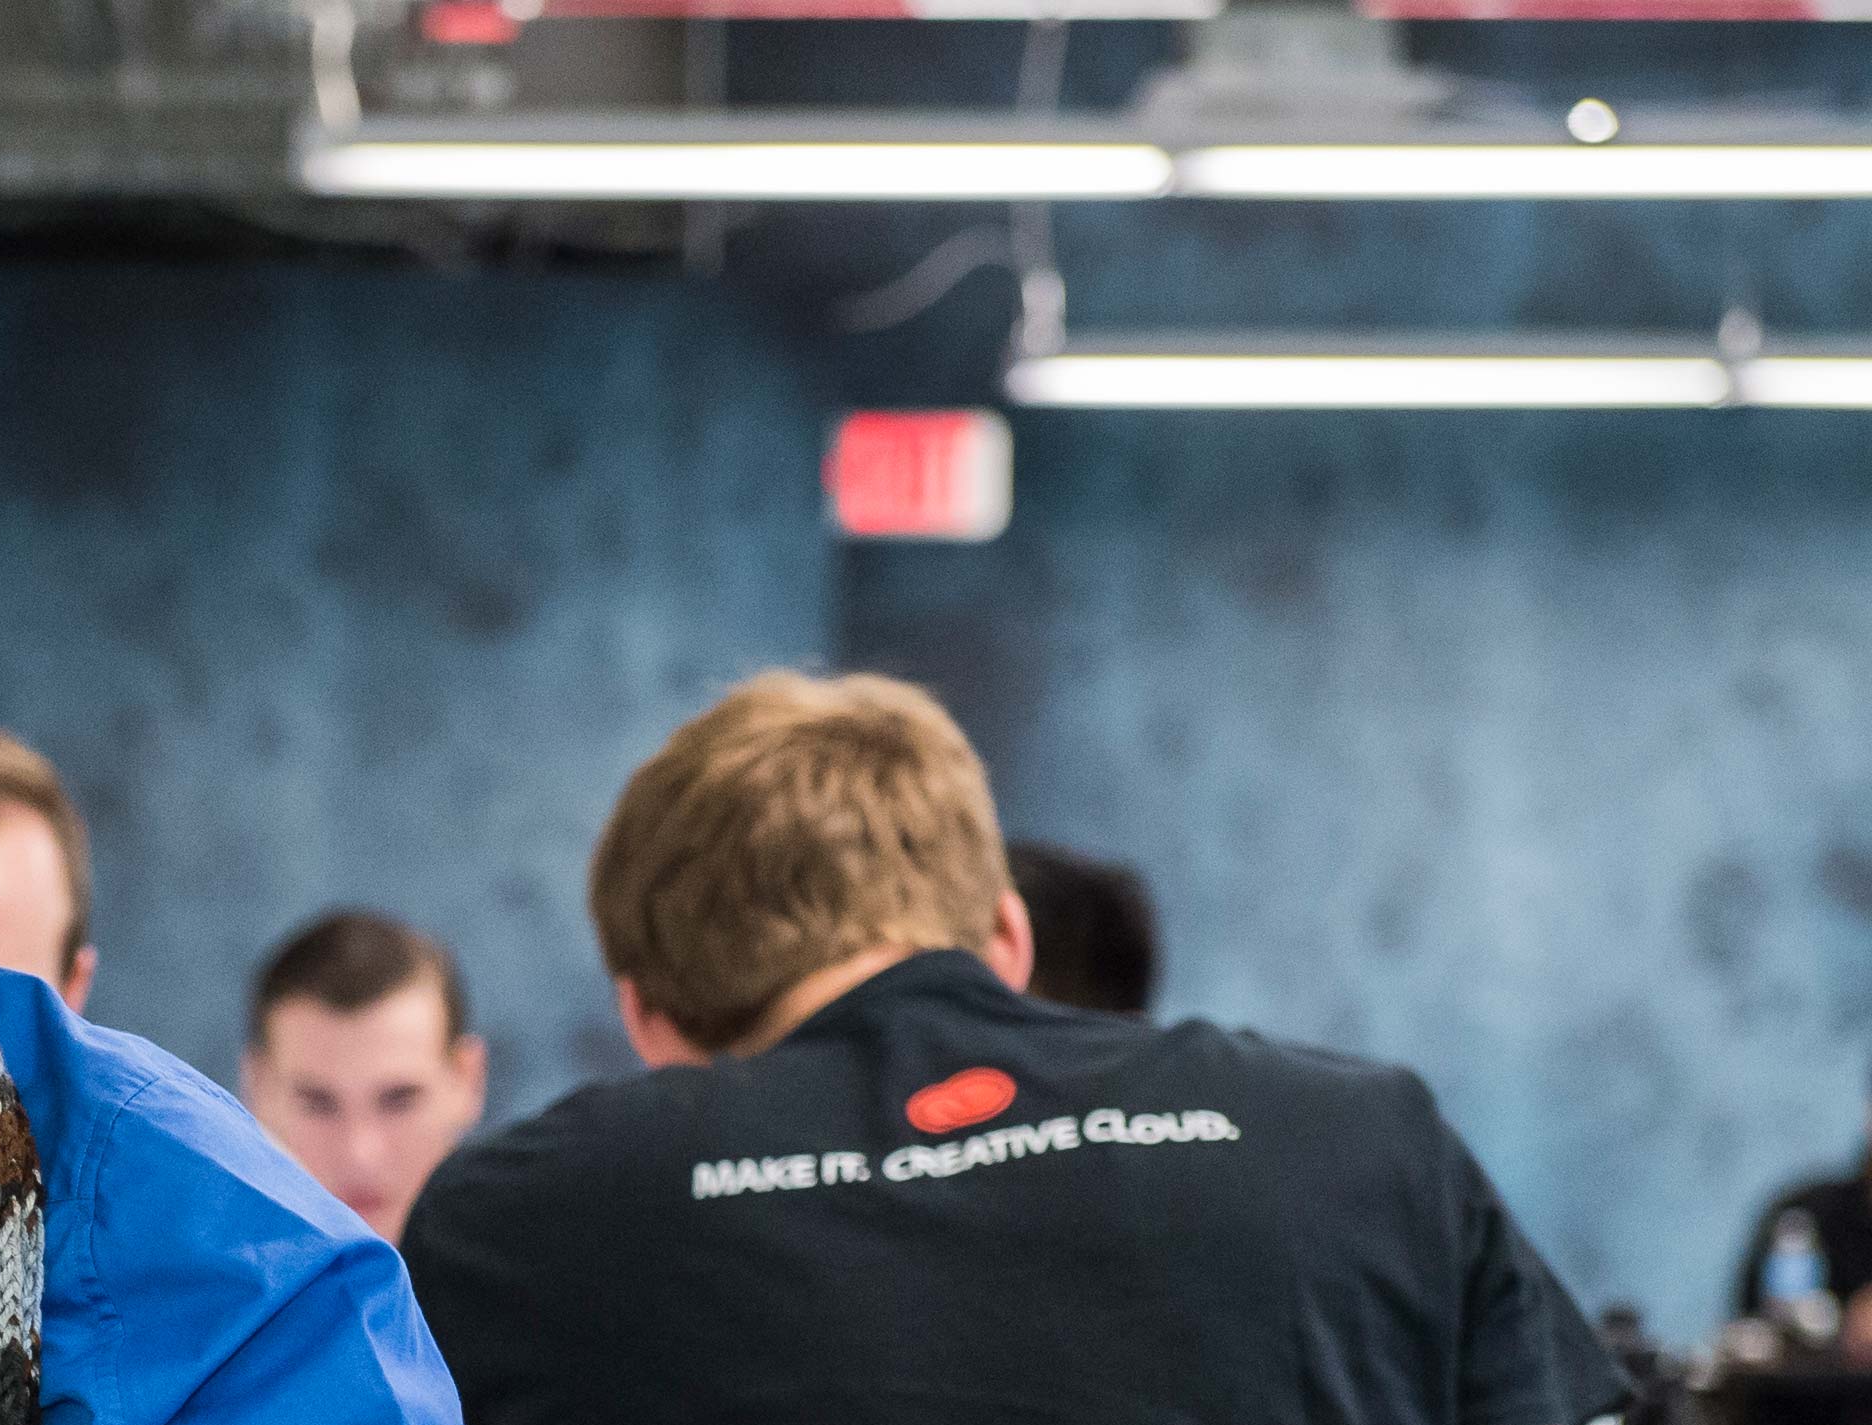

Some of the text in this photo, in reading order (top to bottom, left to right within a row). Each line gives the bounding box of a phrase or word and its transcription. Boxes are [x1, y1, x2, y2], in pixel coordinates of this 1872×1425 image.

[692, 1153, 818, 1200] MAKE
[820, 1151, 871, 1186] IT.
[881, 1115, 1081, 1182] CREATIVE
